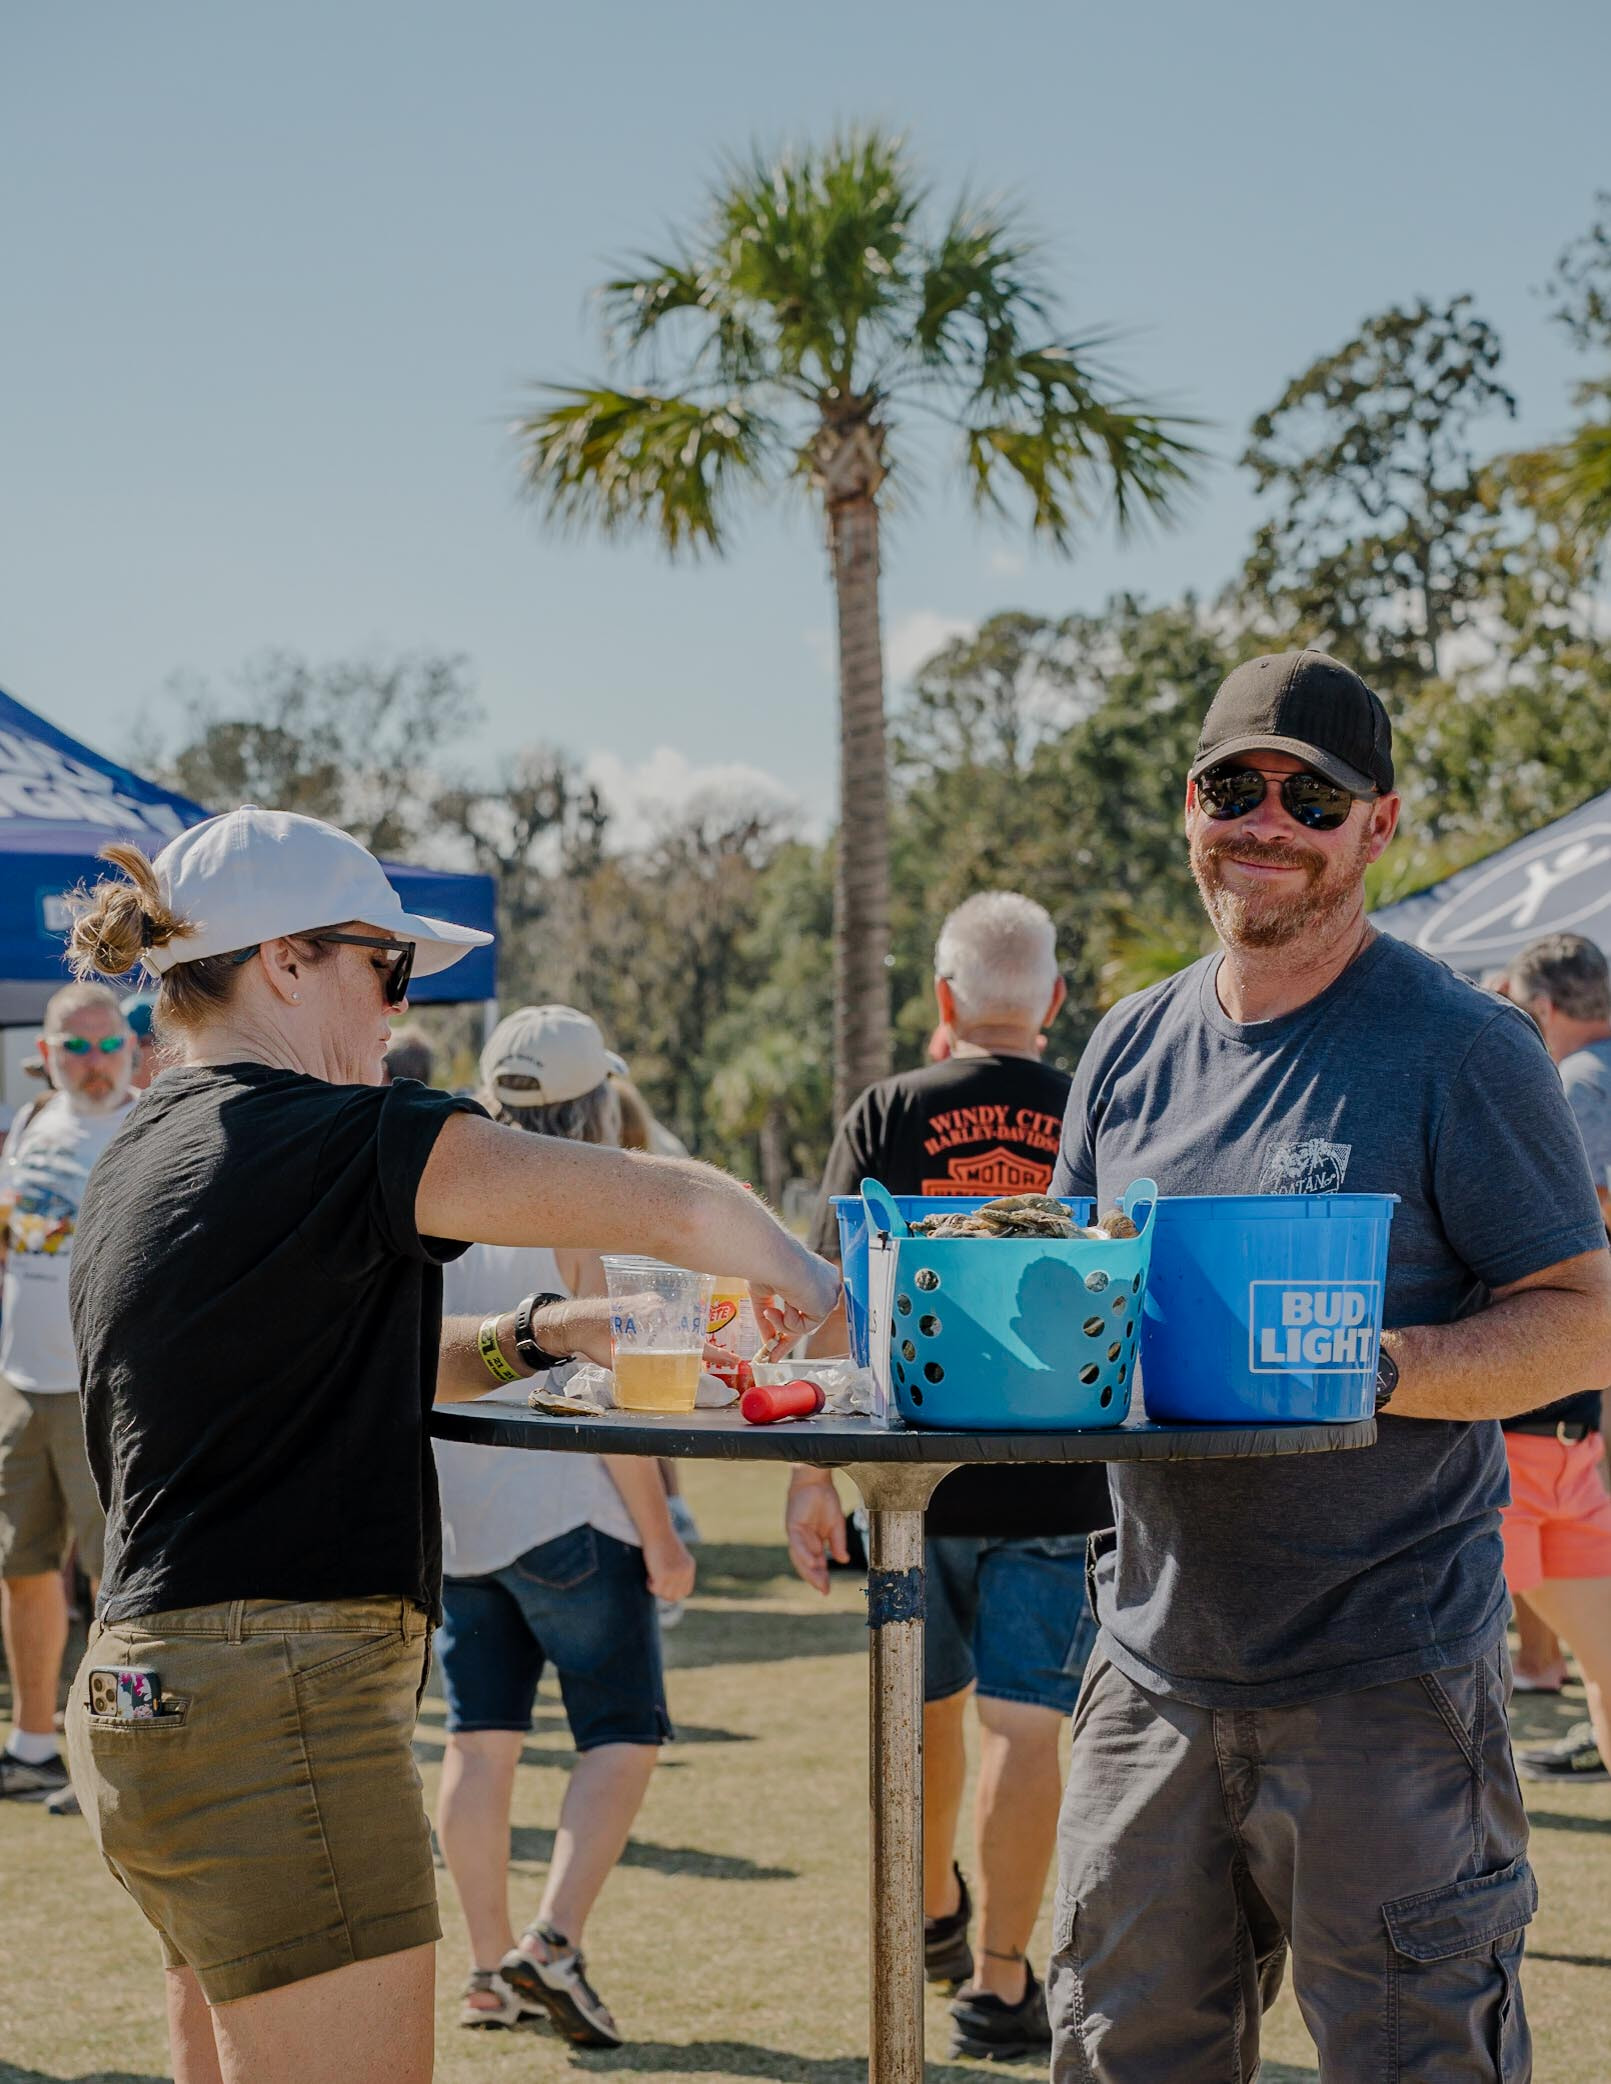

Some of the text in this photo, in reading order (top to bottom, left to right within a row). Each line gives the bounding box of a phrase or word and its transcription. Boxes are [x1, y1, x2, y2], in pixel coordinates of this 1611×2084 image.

[928, 1104, 1062, 1135] WINDY CIT
[923, 1125, 1060, 1156] HARLEY-DAVIDS
[967, 1161, 1036, 1185] MOTOR
[709, 1305, 729, 1323] ETE
[1281, 1291, 1366, 1327] BUD
[611, 1316, 638, 1335] RA
[1260, 1327, 1374, 1363] LIGHT
